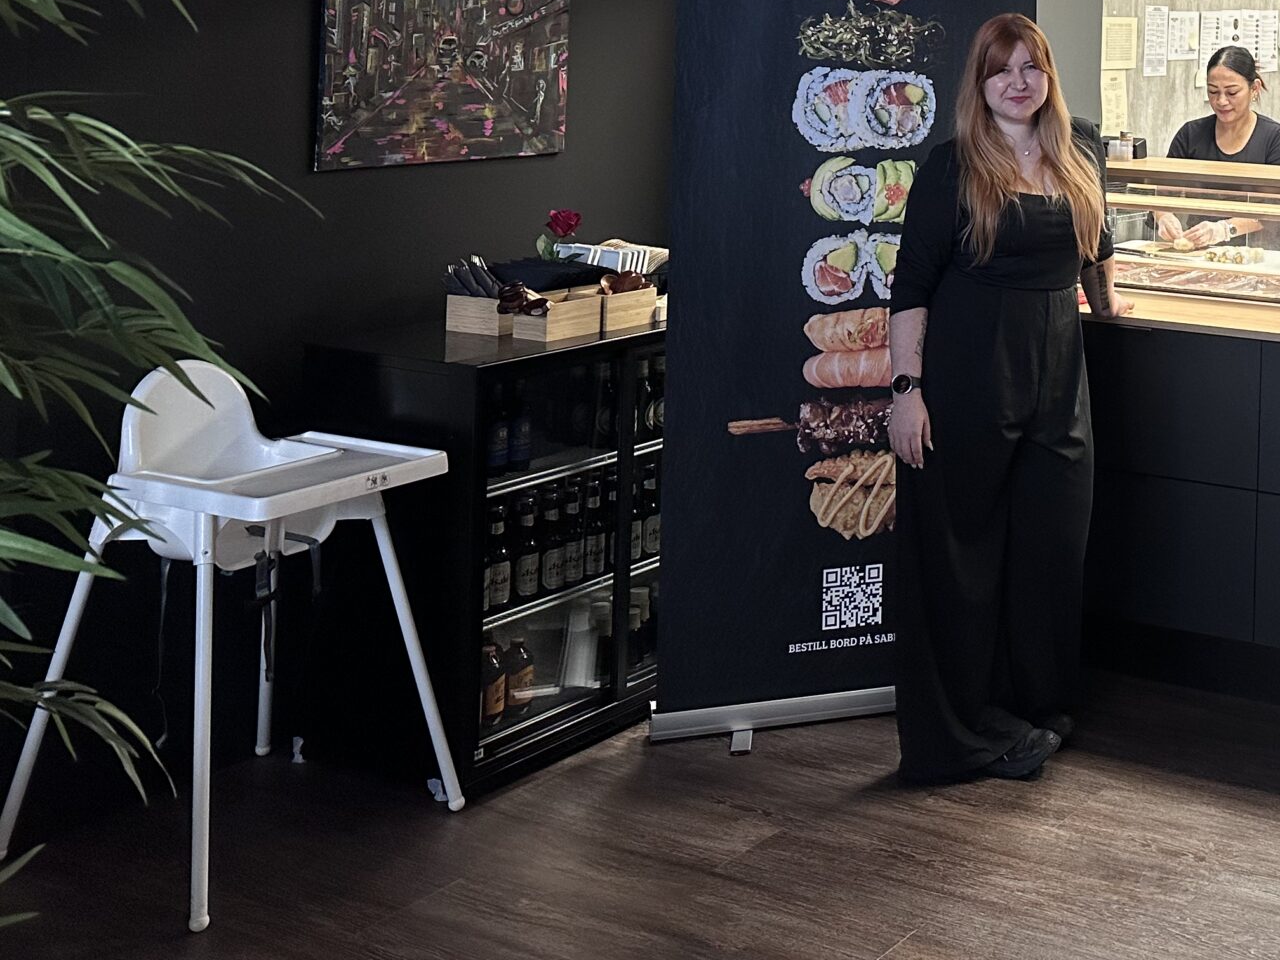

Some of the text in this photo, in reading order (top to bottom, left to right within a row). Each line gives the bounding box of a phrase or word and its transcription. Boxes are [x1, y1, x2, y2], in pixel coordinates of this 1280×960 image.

[788, 640, 829, 654] BESTILL
[830, 637, 858, 649] BORD
[859, 633, 873, 646] PÅ
